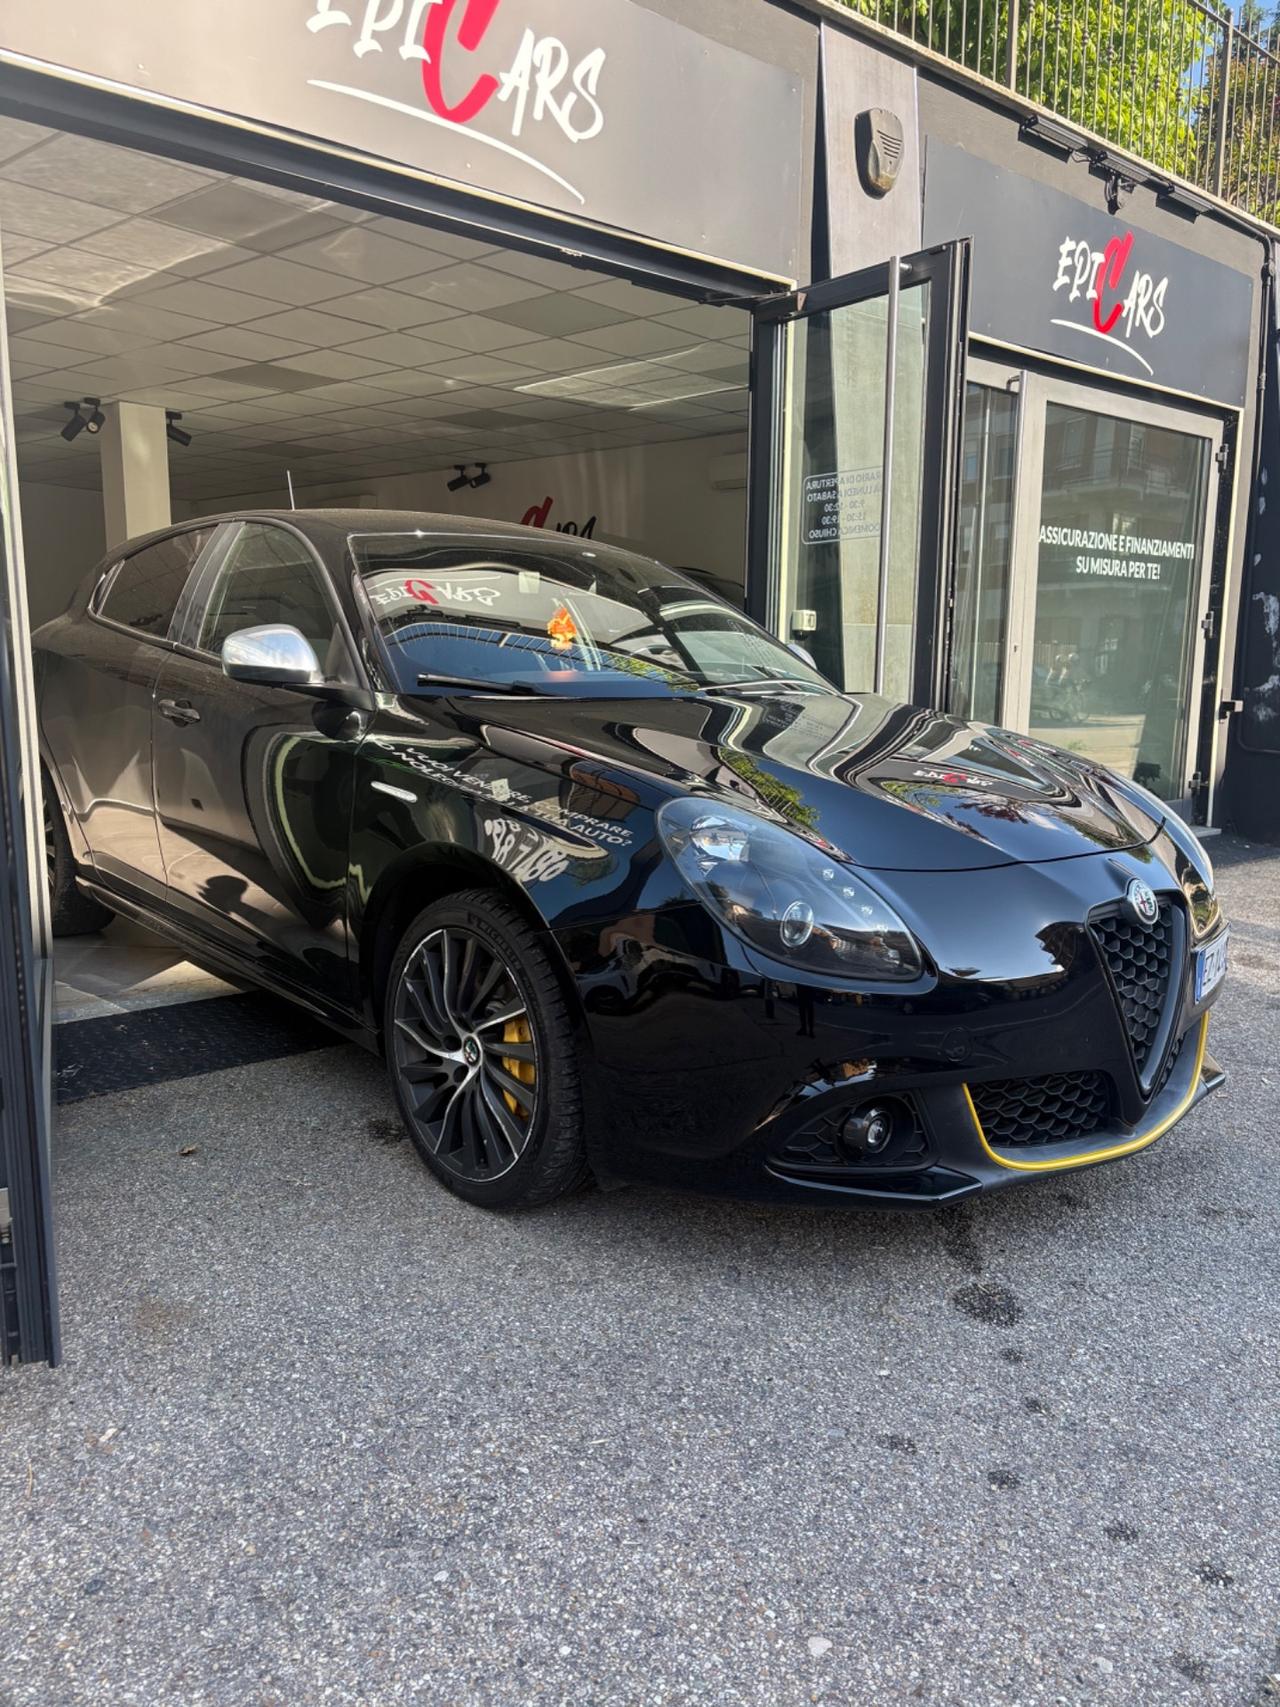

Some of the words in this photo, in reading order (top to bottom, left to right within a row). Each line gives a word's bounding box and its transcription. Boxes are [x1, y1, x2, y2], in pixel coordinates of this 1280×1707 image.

[1052, 230, 1169, 339] EPICARS
[1038, 525, 1118, 552] ASSICURAZIONE
[1118, 536, 1125, 552] E
[1125, 536, 1195, 560] FINANZIAMENTI
[1075, 556, 1090, 573] SU
[1090, 557, 1128, 578] MISURA
[1128, 561, 1146, 579] PER
[1146, 563, 1161, 580] TE!
[533, 801, 634, 837] COMPRARE
[571, 824, 633, 847] AUTO?
